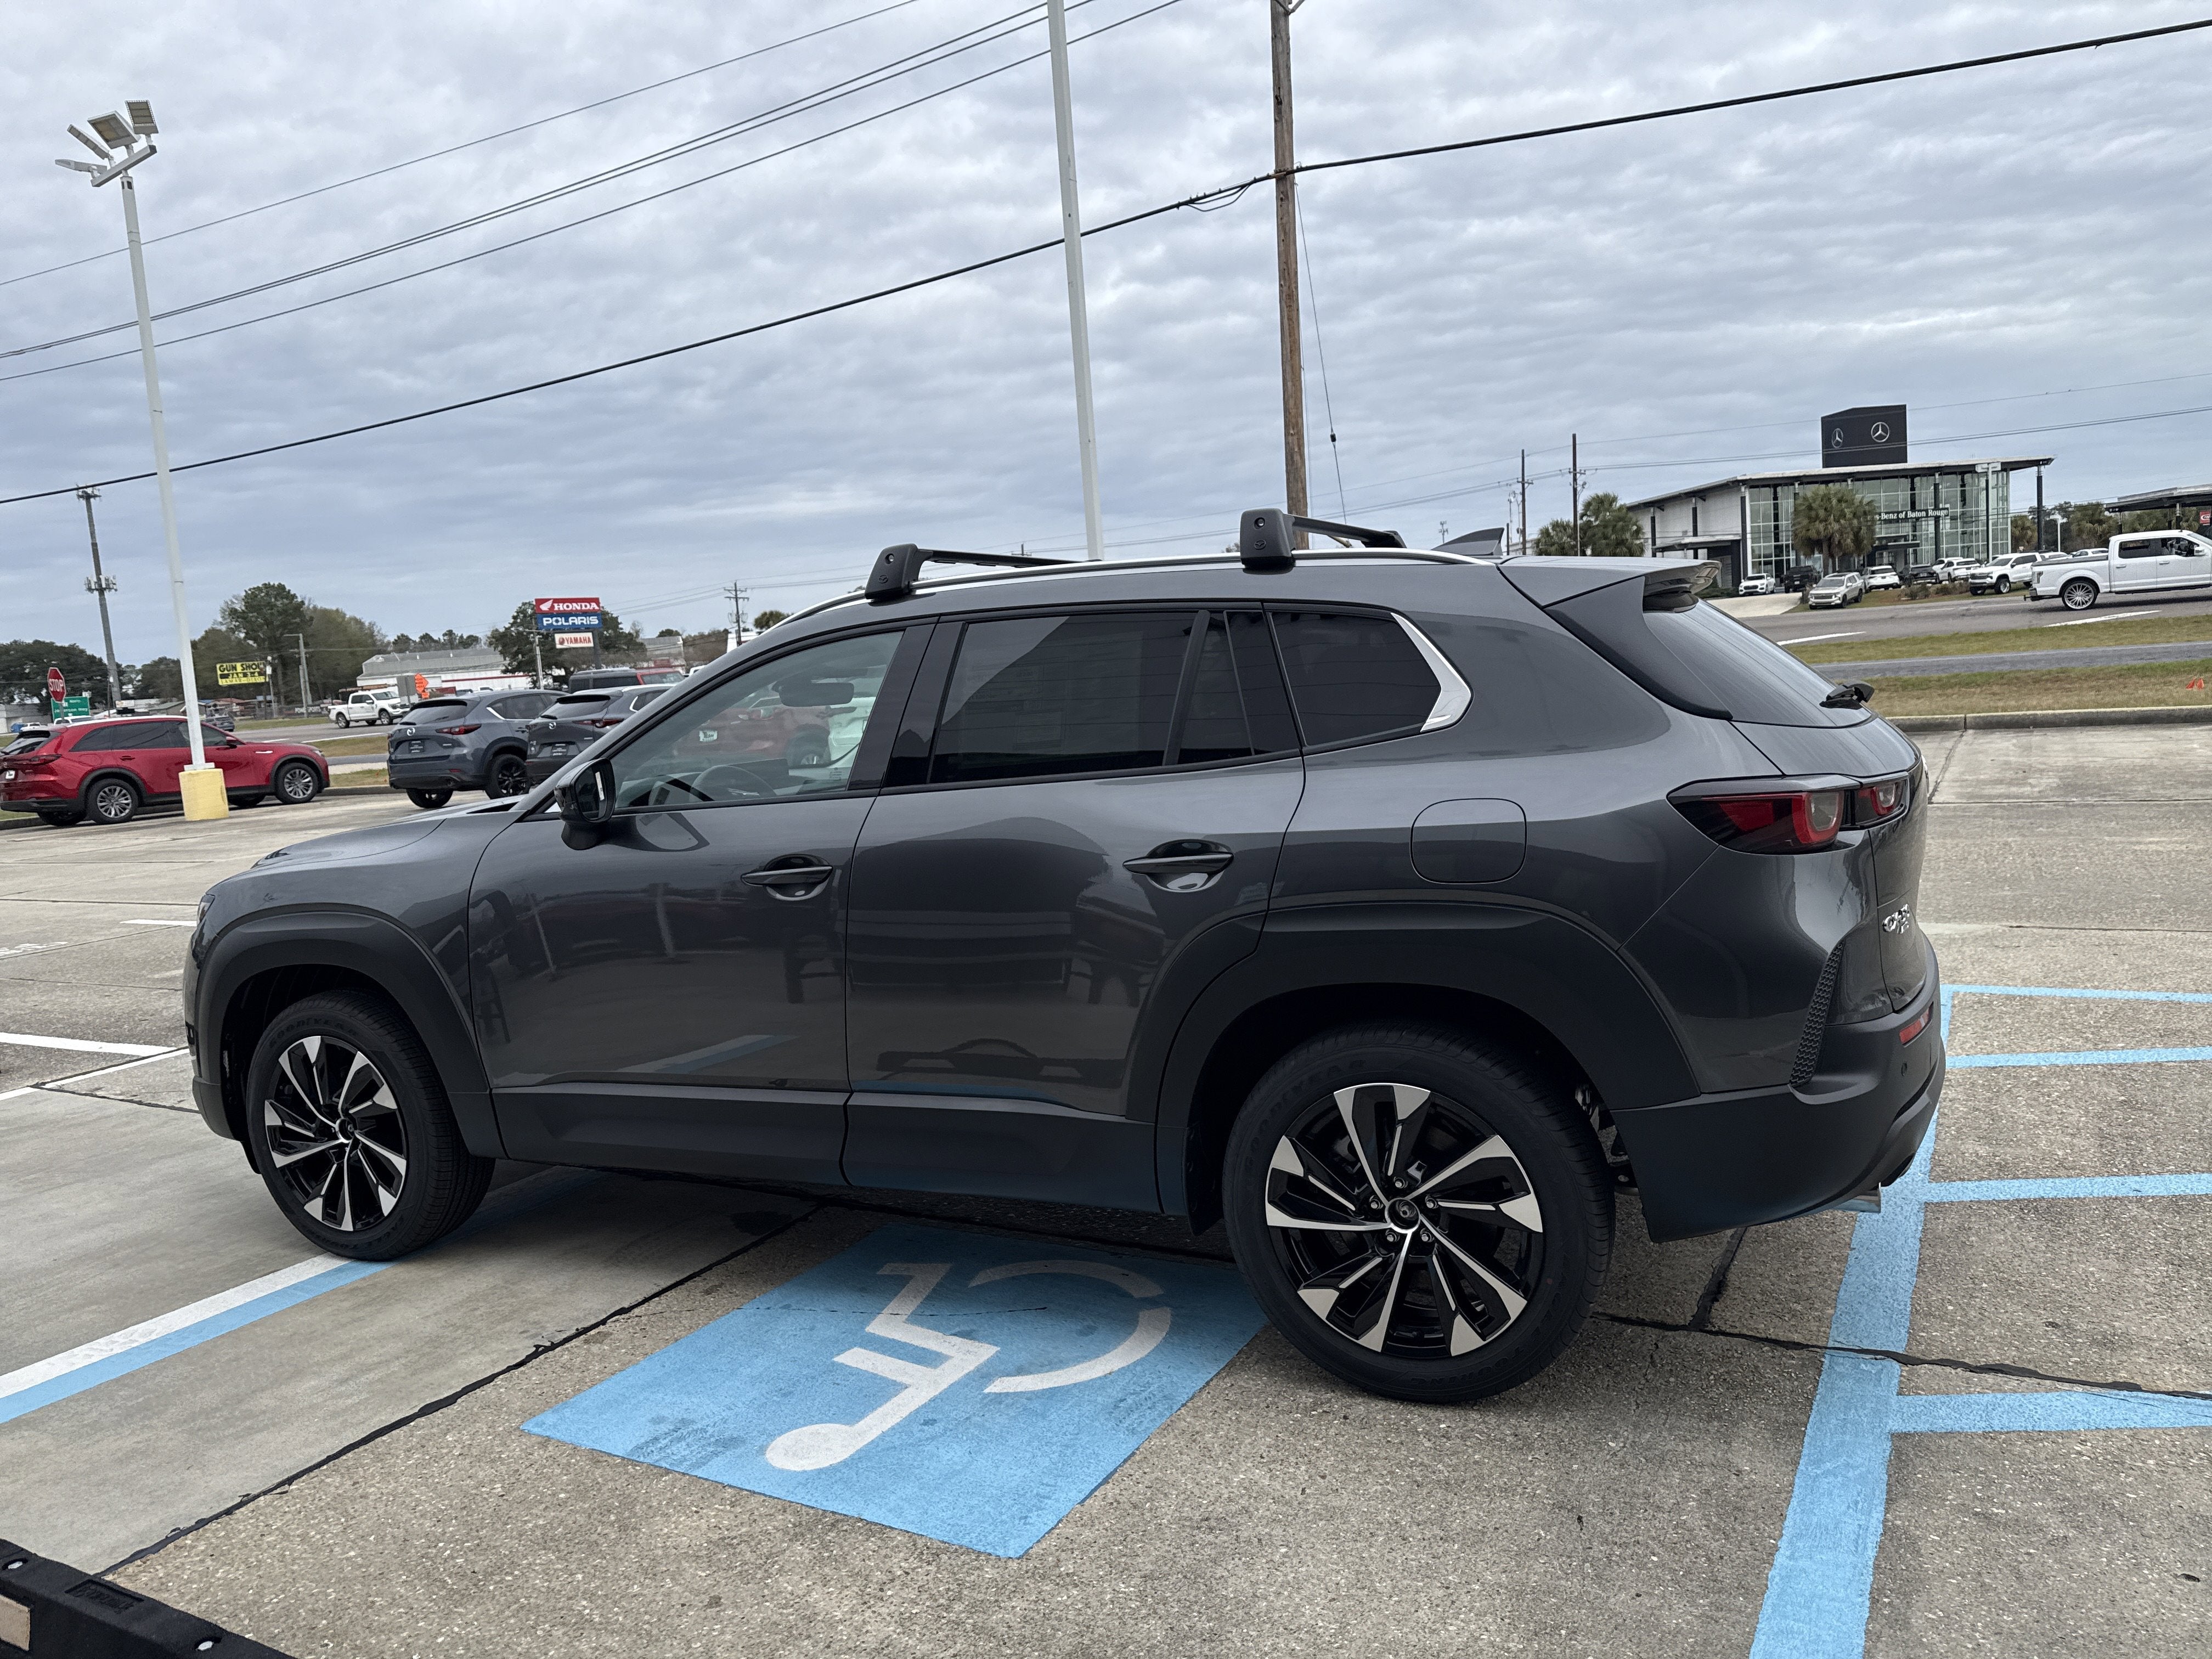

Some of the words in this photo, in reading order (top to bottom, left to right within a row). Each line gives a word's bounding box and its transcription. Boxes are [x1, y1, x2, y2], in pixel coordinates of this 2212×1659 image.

[1928, 509, 1948, 517] Rouge
[553, 602, 600, 611] HONDA
[543, 616, 599, 626] POLARIS
[565, 636, 592, 645] YAMAHA
[49, 678, 64, 692] STOP
